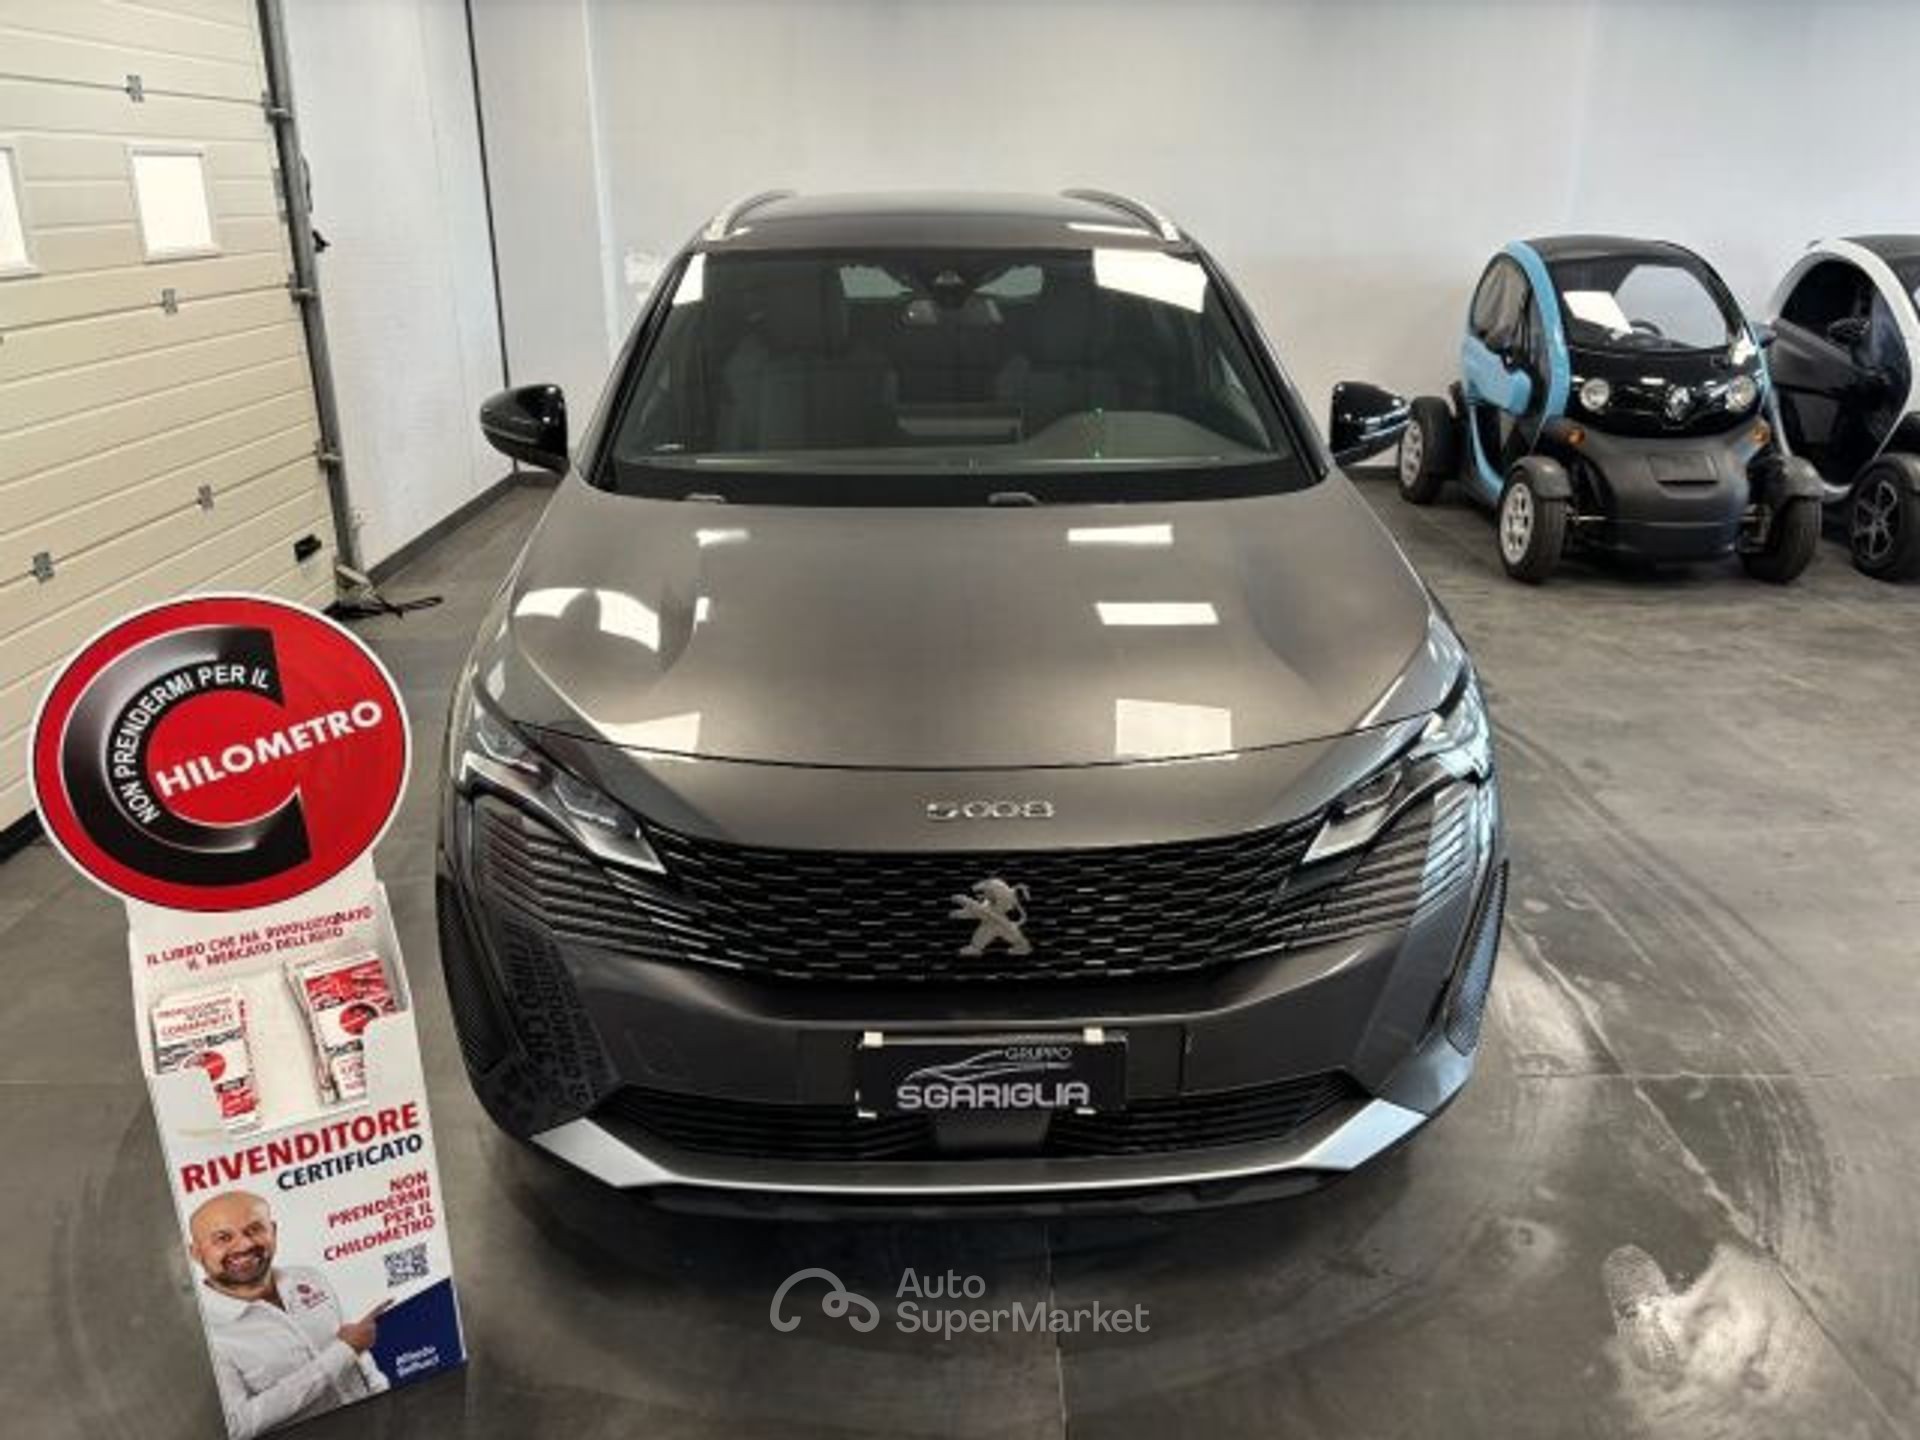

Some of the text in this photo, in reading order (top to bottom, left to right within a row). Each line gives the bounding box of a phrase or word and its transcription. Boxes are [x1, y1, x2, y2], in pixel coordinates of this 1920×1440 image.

[113, 663, 270, 826] NON PRENDERMI PER IL
[156, 701, 383, 797] HILOMETRO
[926, 800, 1056, 822] 5008
[162, 942, 205, 963] LIBRO
[209, 935, 238, 952] CHE
[266, 906, 373, 939] RIVOLUZIONATO
[206, 941, 271, 966] MERCATO
[1004, 1046, 1072, 1060] GRUPPO
[896, 1081, 1090, 1110] SGARIGLIA
[180, 1102, 420, 1193] RIVENDITORE
[276, 1133, 424, 1191] CERTIFICATO
[389, 1170, 428, 1192] NON
[328, 1186, 431, 1227] PRENDERMI
[383, 1202, 434, 1227] PER IL
[324, 1215, 436, 1261] CHILOMETRO
